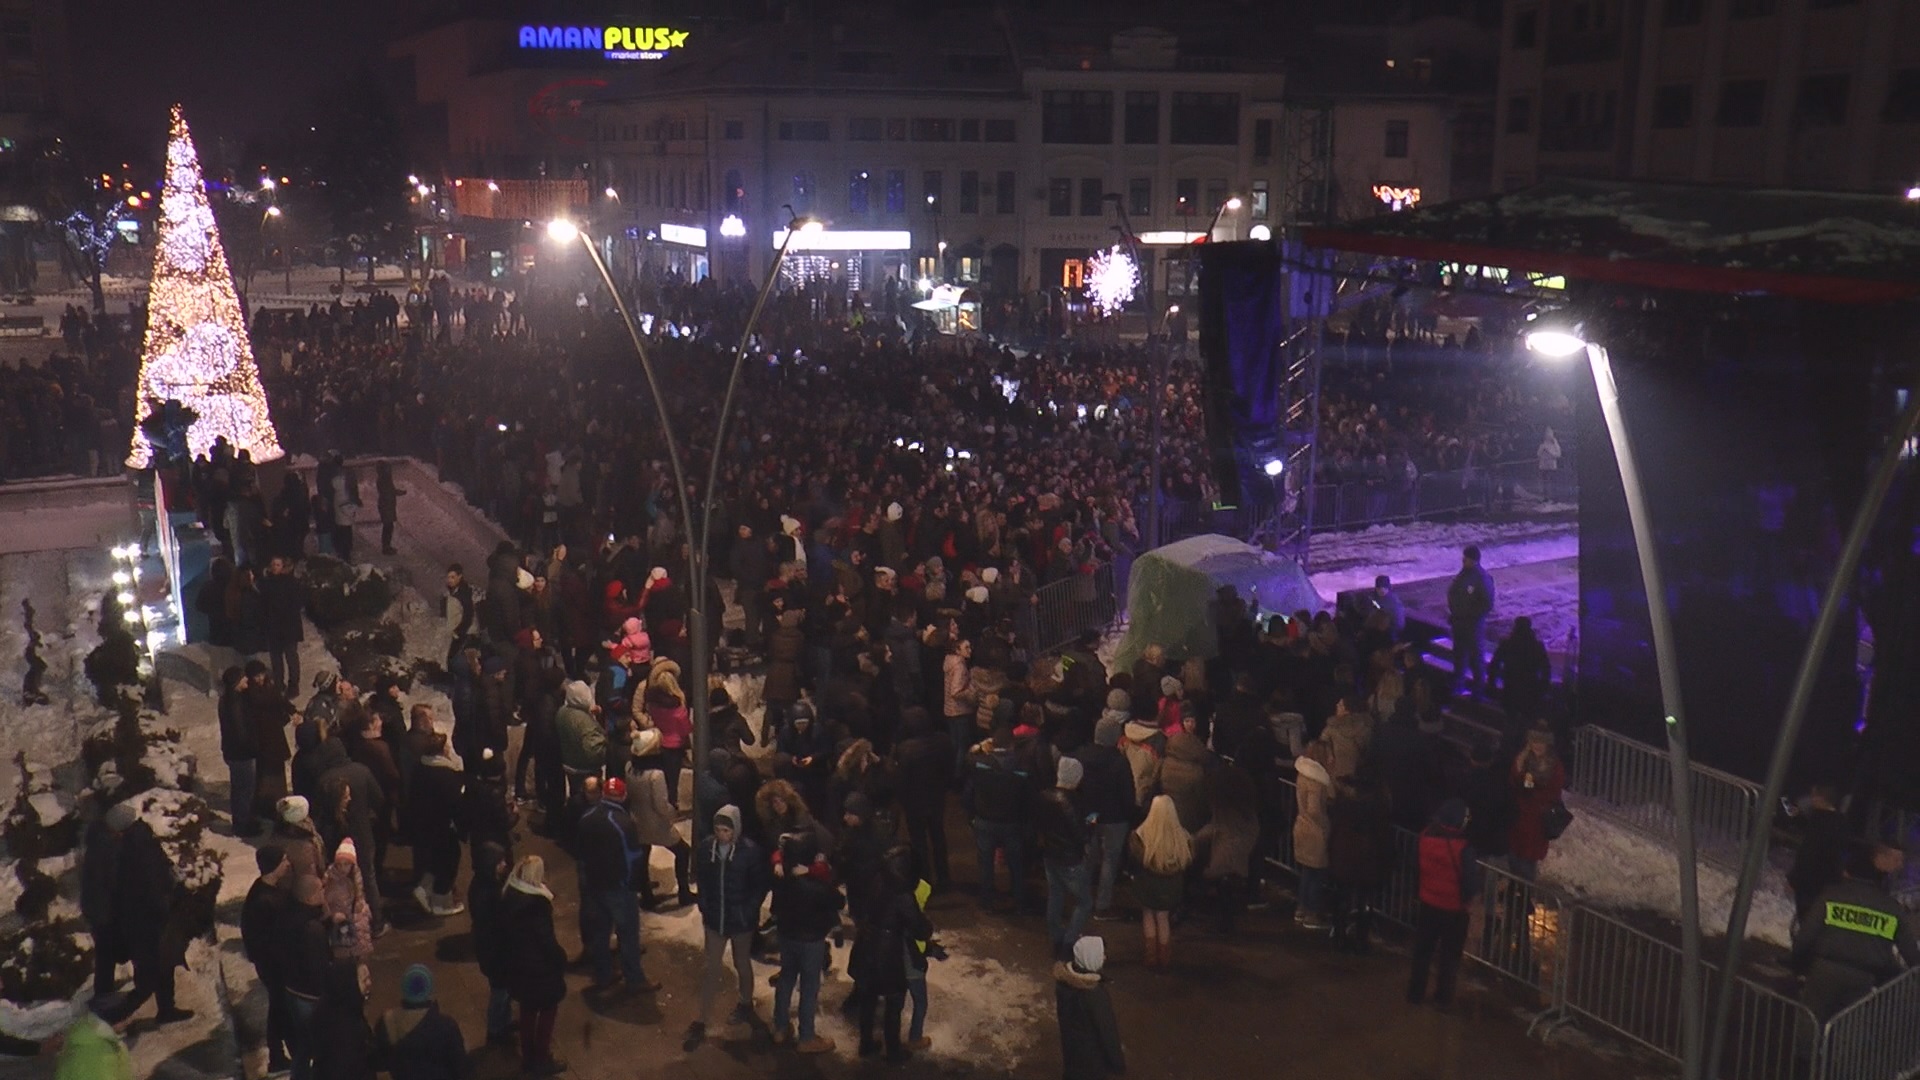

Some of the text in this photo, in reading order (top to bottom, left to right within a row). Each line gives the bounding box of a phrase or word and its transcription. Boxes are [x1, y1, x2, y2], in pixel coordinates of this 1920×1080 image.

[519, 26, 670, 50] AMAN PLUS
[611, 52, 663, 60] market store
[1832, 906, 1889, 931] SECURITY
